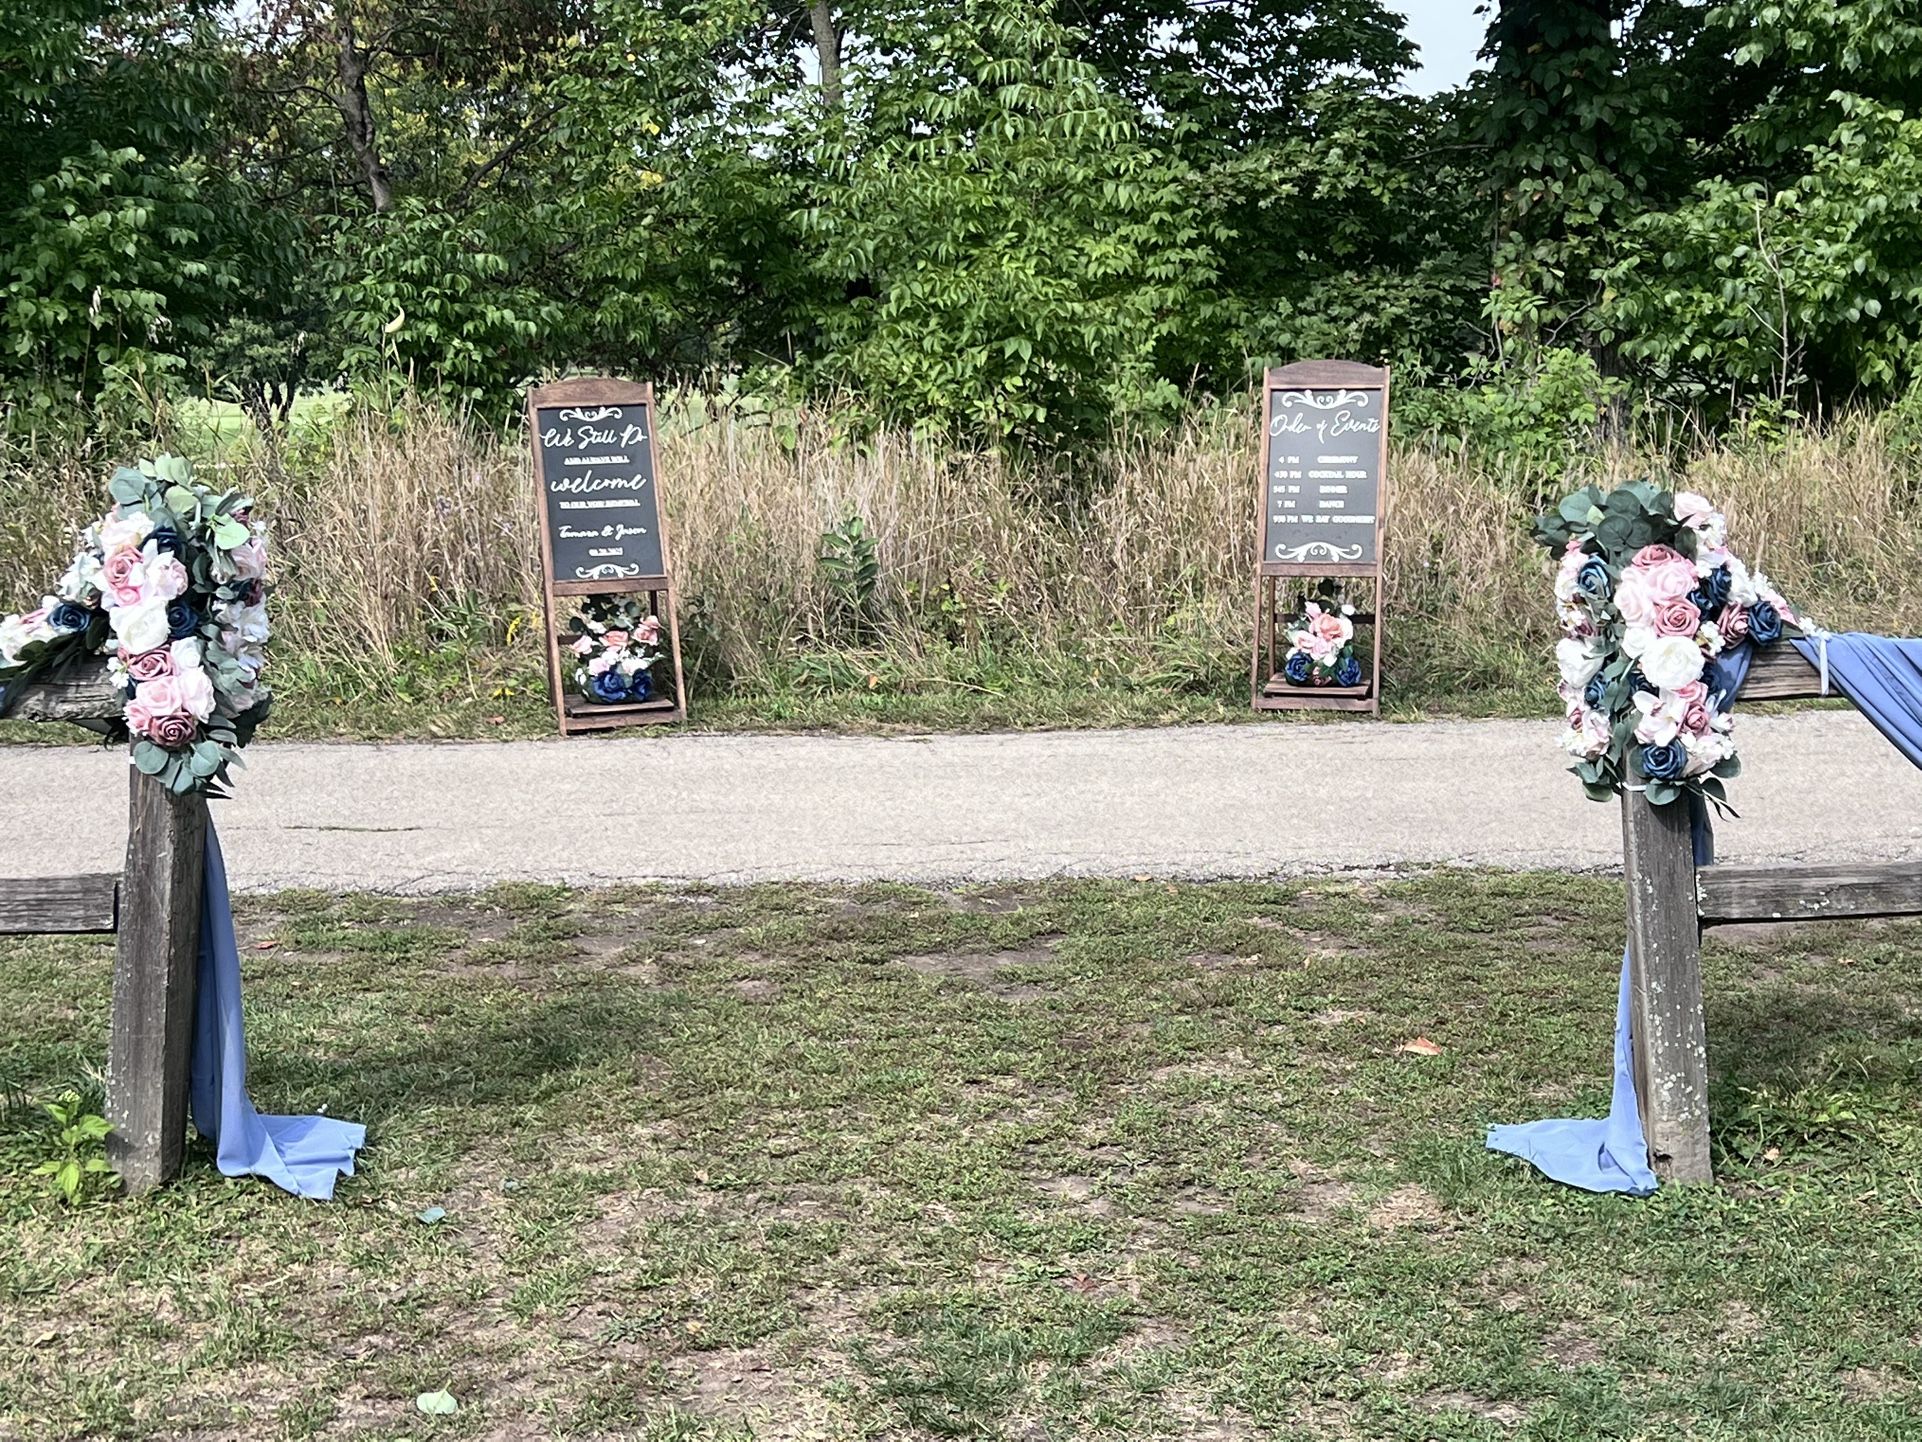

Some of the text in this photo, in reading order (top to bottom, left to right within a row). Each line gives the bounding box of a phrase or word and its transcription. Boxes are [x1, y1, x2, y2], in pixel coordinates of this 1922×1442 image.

[577, 425, 617, 449] Still
[1269, 410, 1380, 444] Order of Events
[550, 469, 647, 493] welcome
[601, 524, 614, 536] &
